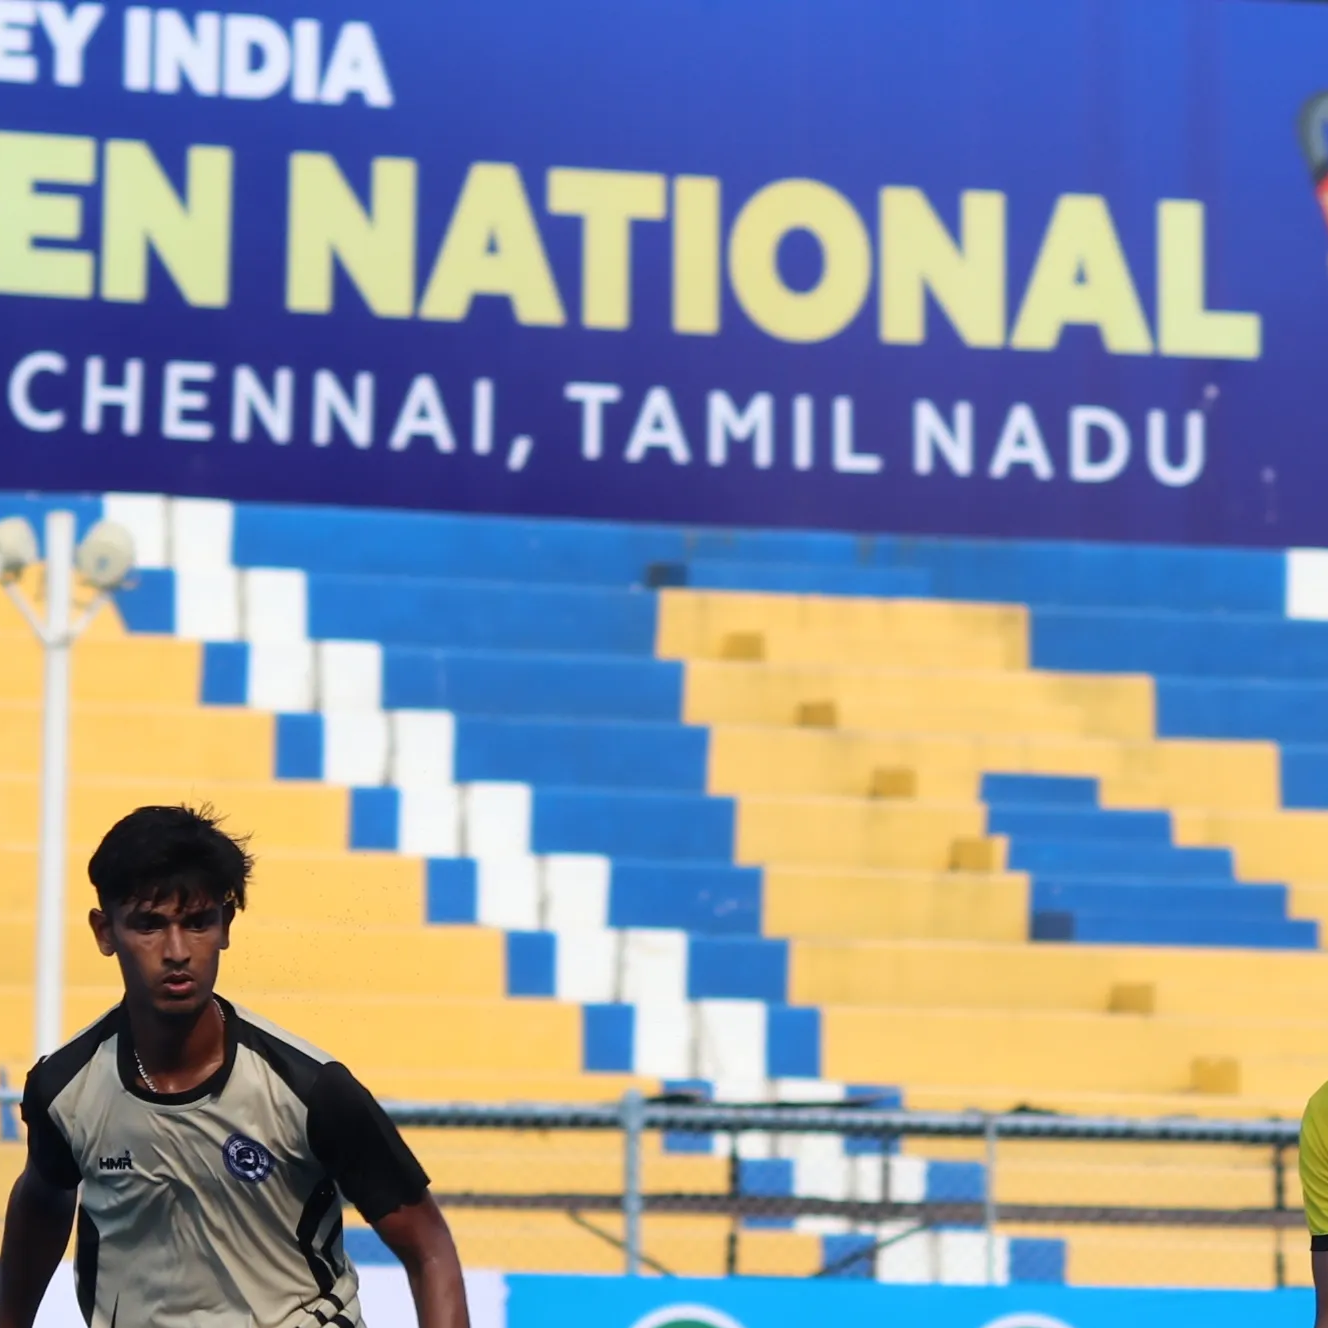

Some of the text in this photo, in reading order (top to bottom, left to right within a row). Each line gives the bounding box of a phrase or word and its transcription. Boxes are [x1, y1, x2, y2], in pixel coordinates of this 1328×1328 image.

[124, 7, 394, 108] INDIA
[286, 151, 1262, 360] NATIONAL
[8, 353, 531, 470] CHENNAI,
[565, 383, 883, 473] TAMIL
[914, 400, 1205, 486] NADU
